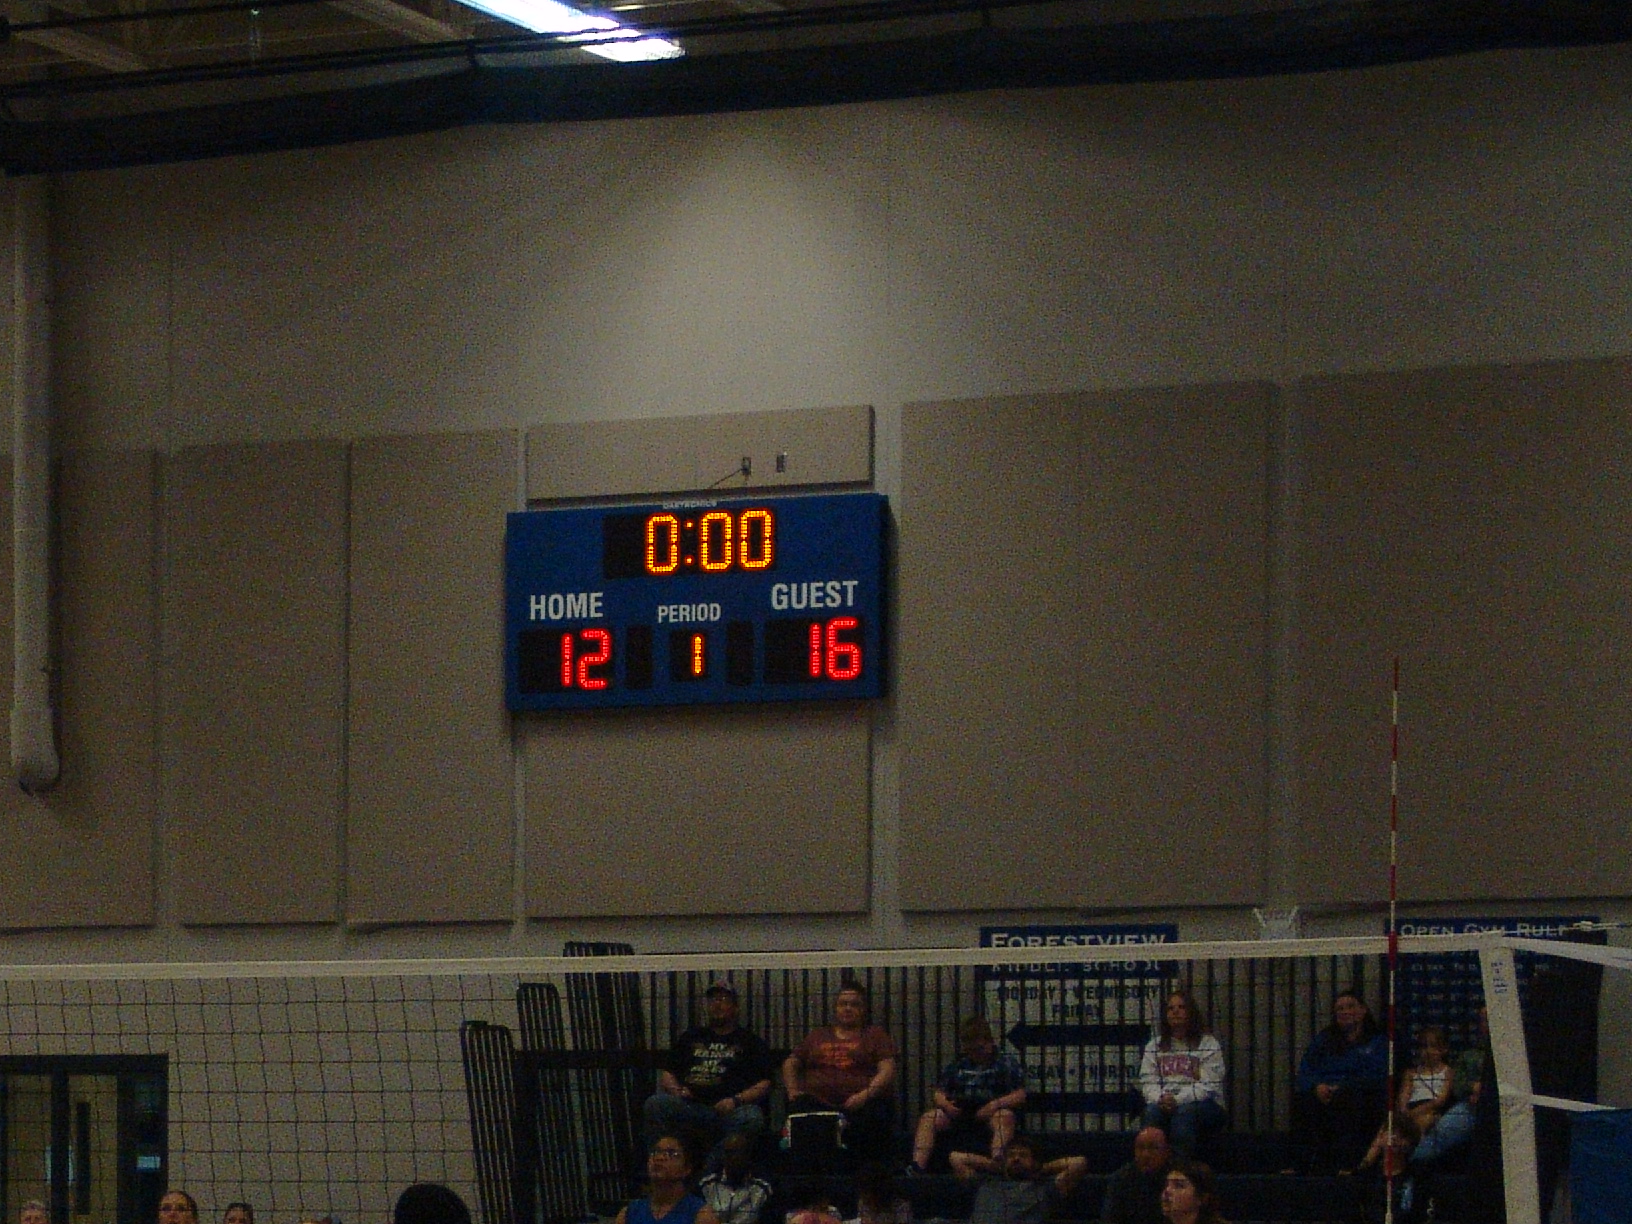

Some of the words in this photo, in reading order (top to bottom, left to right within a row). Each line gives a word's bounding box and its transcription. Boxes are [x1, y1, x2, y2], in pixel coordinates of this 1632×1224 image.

[645, 508, 775, 576] 0:00
[530, 592, 604, 621] HOME
[771, 580, 859, 611] GUEST
[657, 602, 722, 623] PERIOD
[560, 627, 613, 691] 12
[691, 633, 706, 676] 1
[808, 616, 864, 680] 16
[991, 932, 1166, 948] FORESTVIEW
